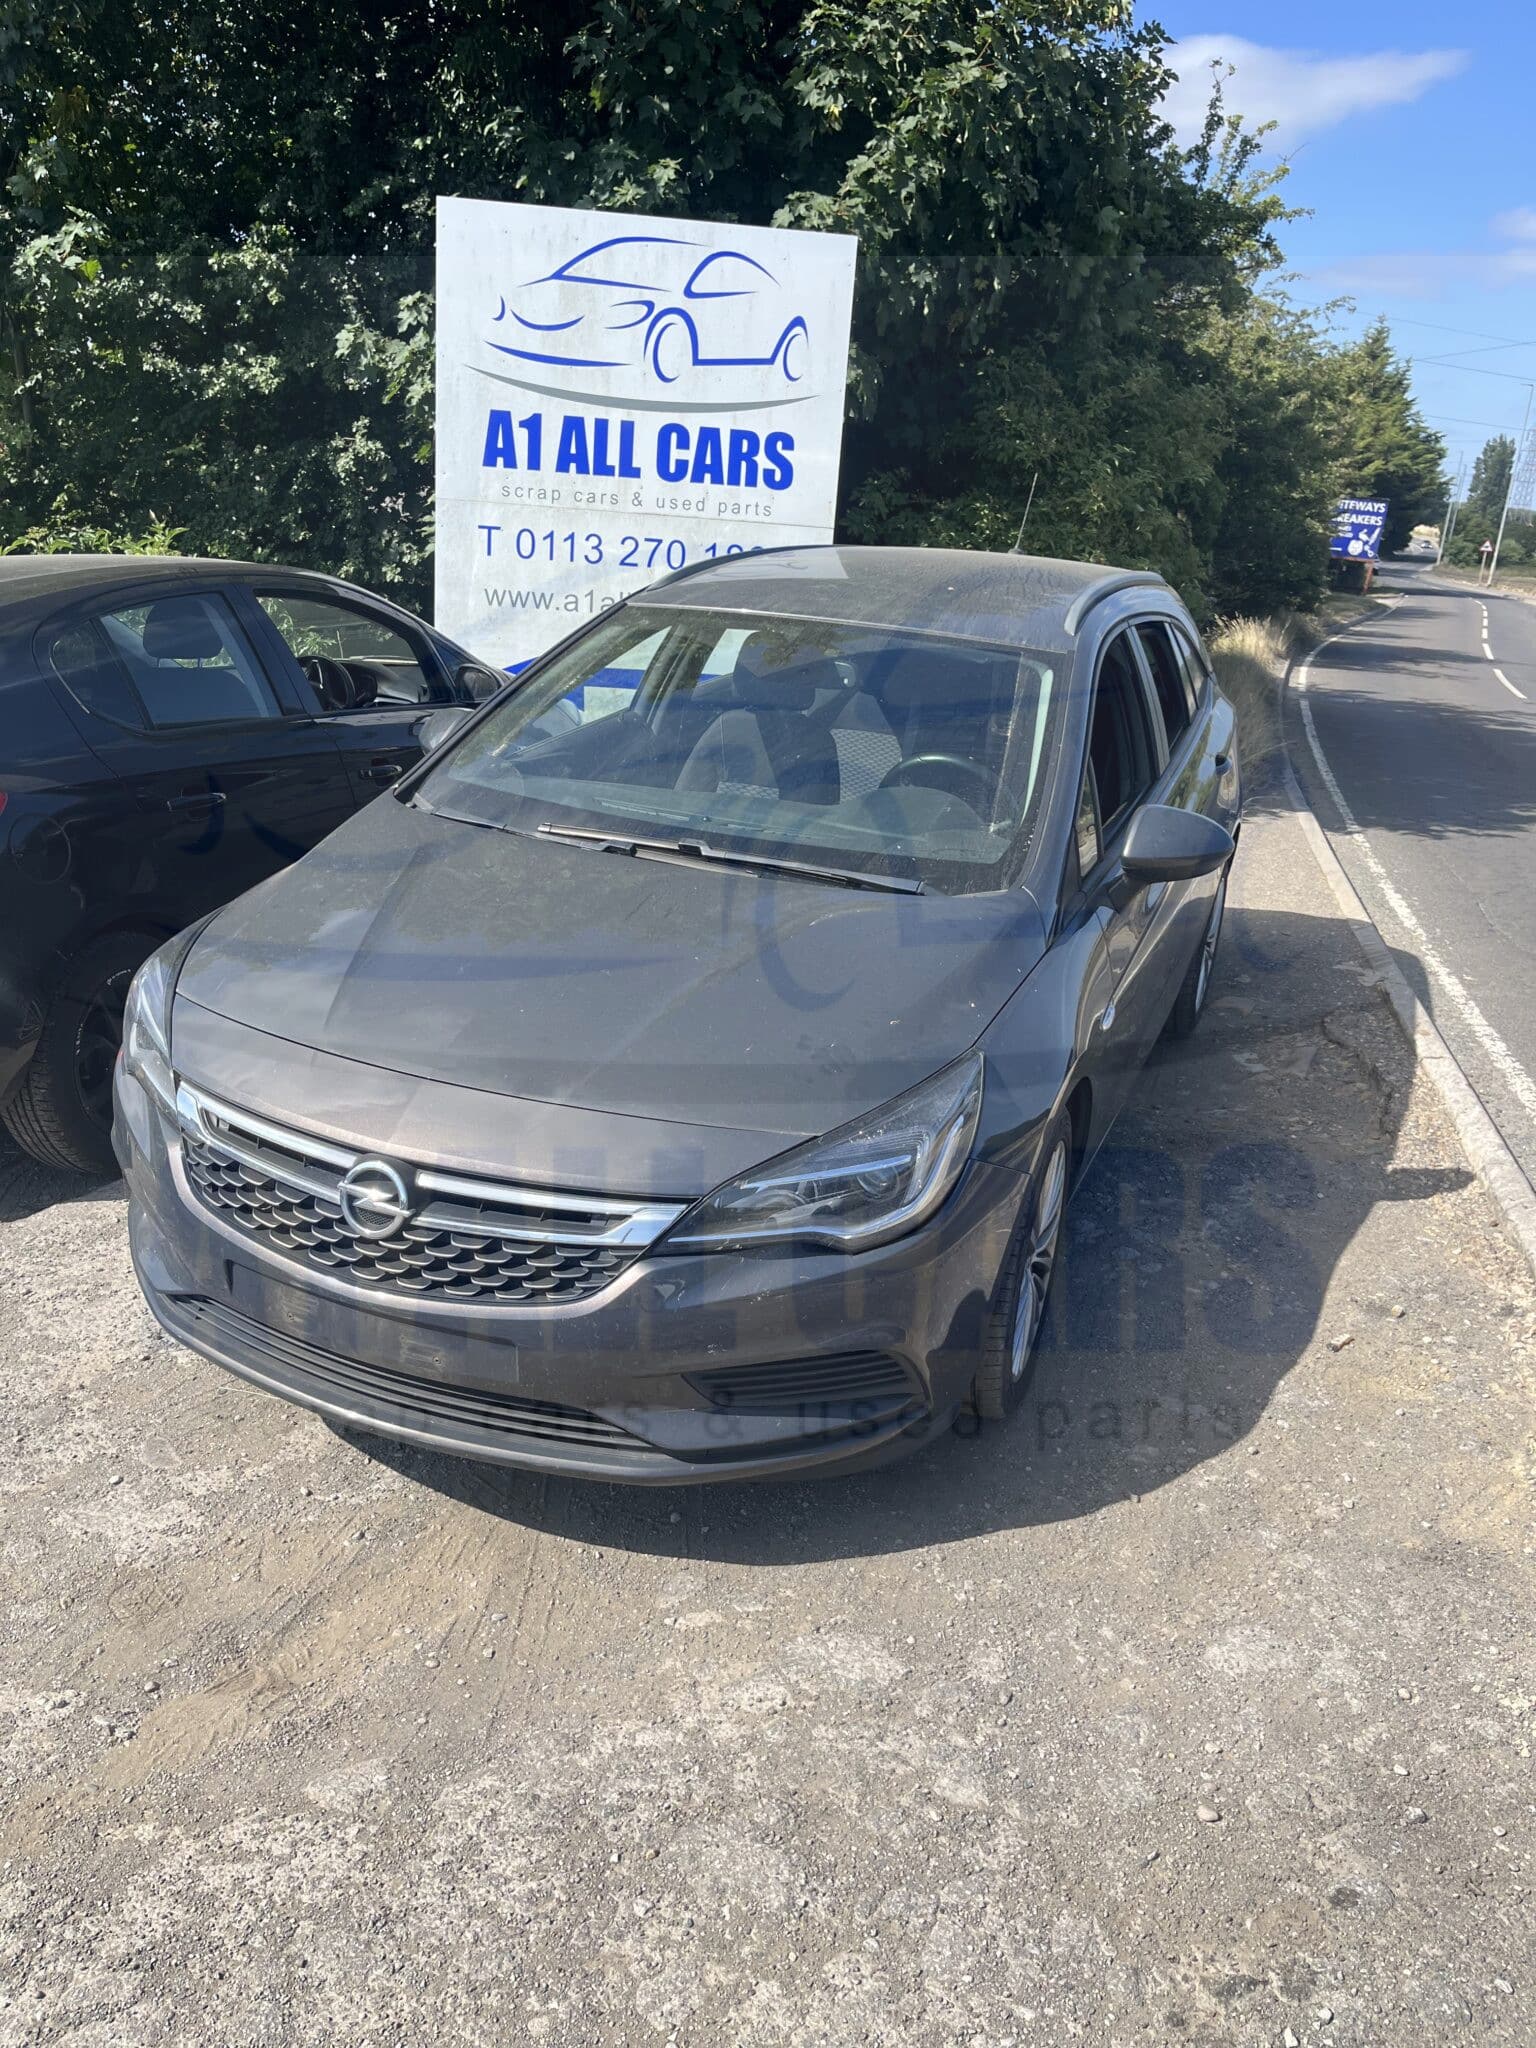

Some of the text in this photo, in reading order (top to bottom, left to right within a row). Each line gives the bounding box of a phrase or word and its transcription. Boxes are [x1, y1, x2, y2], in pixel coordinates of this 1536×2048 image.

[482, 409, 795, 491] A1 ALL CARS
[501, 484, 772, 517] scrap cars & used parts
[478, 524, 501, 556] T
[516, 528, 603, 565] 0113
[619, 535, 687, 571] 270
[484, 588, 633, 614] www.a1a
